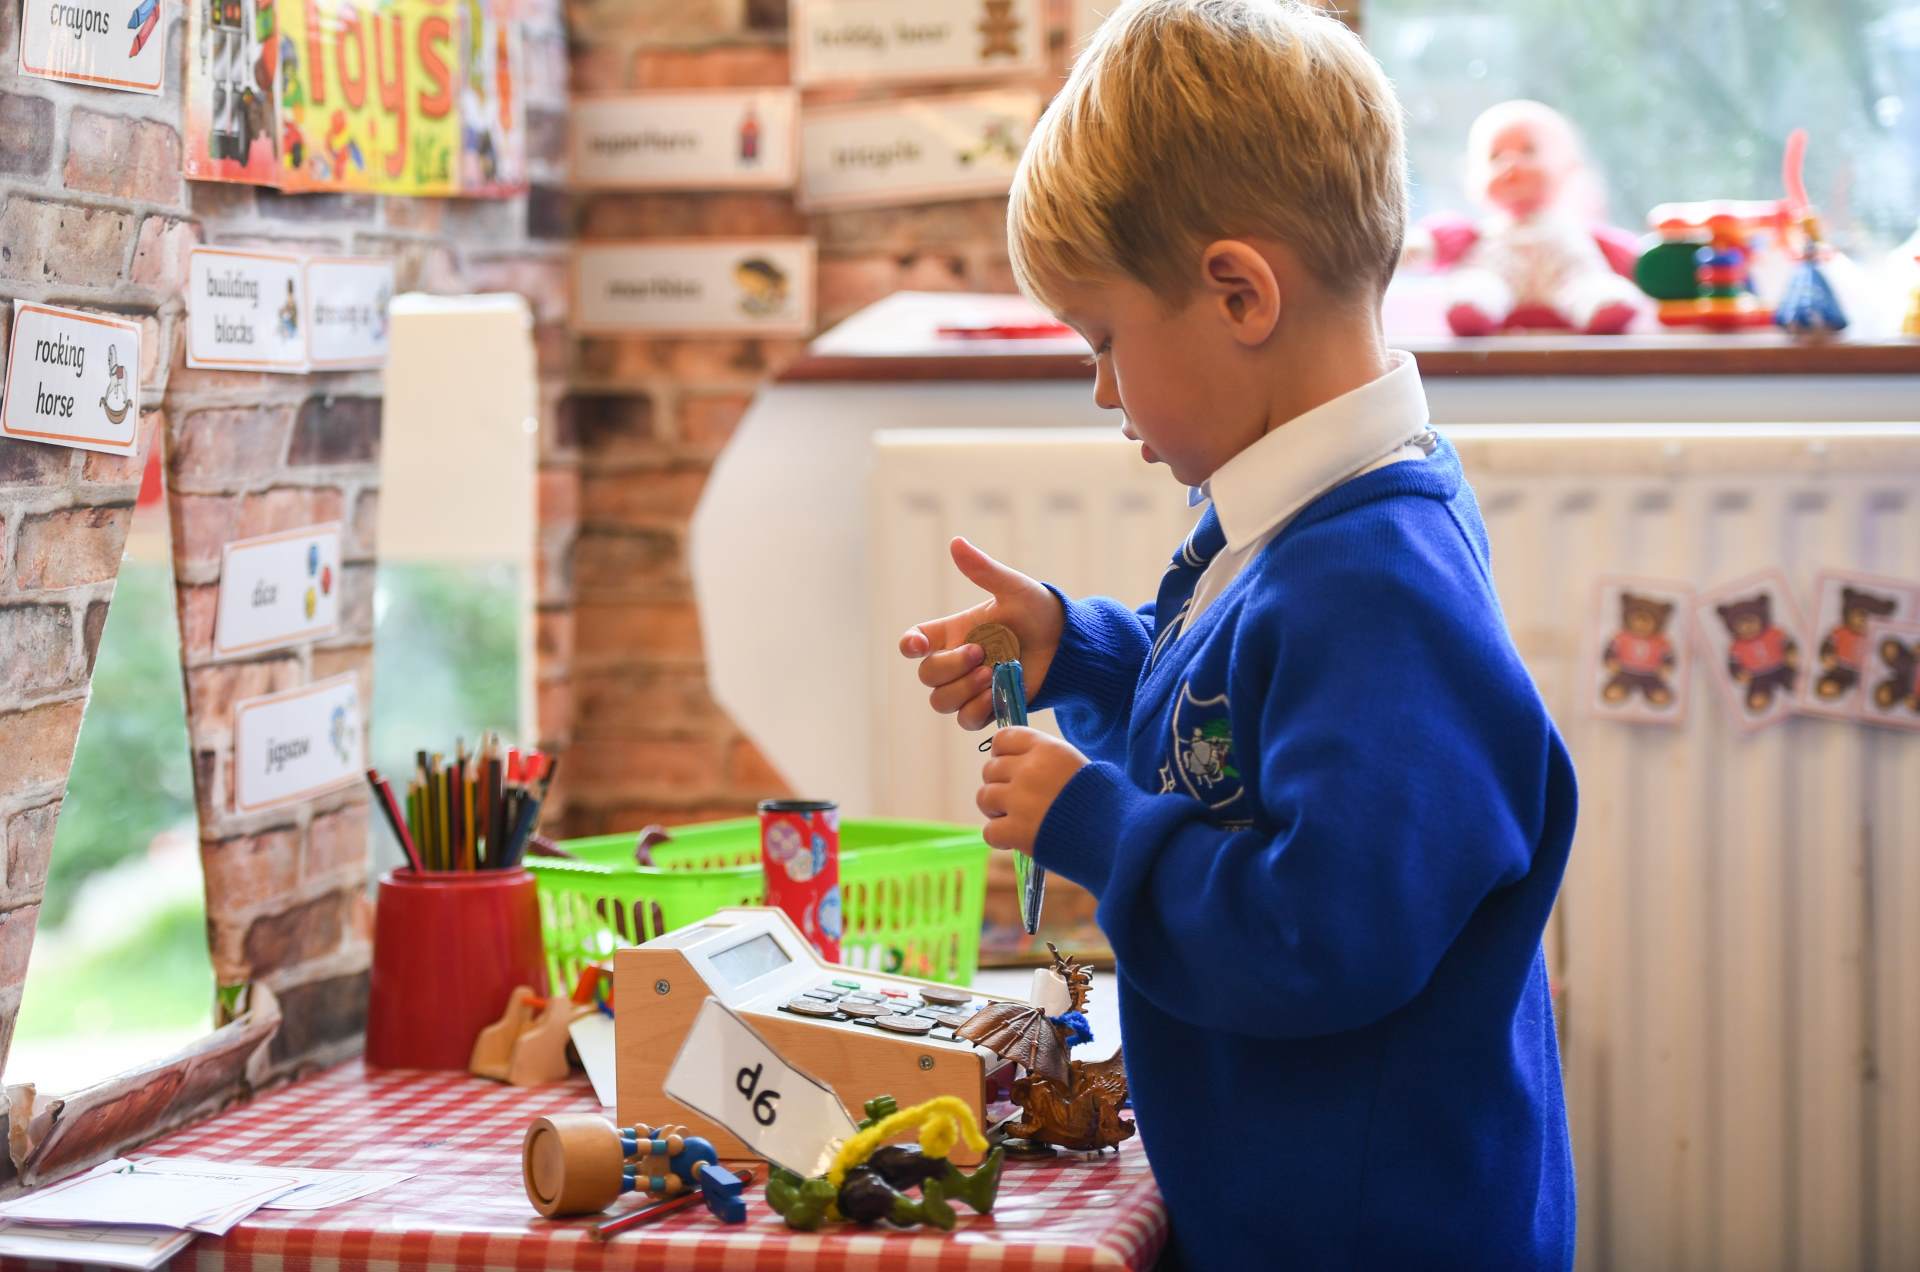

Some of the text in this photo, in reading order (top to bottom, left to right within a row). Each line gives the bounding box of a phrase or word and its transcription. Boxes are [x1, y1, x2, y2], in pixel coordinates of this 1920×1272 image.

[50, 3, 110, 39] crayons
[206, 268, 258, 308] building
[213, 314, 254, 344] blocks
[34, 332, 85, 378] rocking
[35, 381, 74, 418] horse
[264, 738, 310, 774] jigsaw
